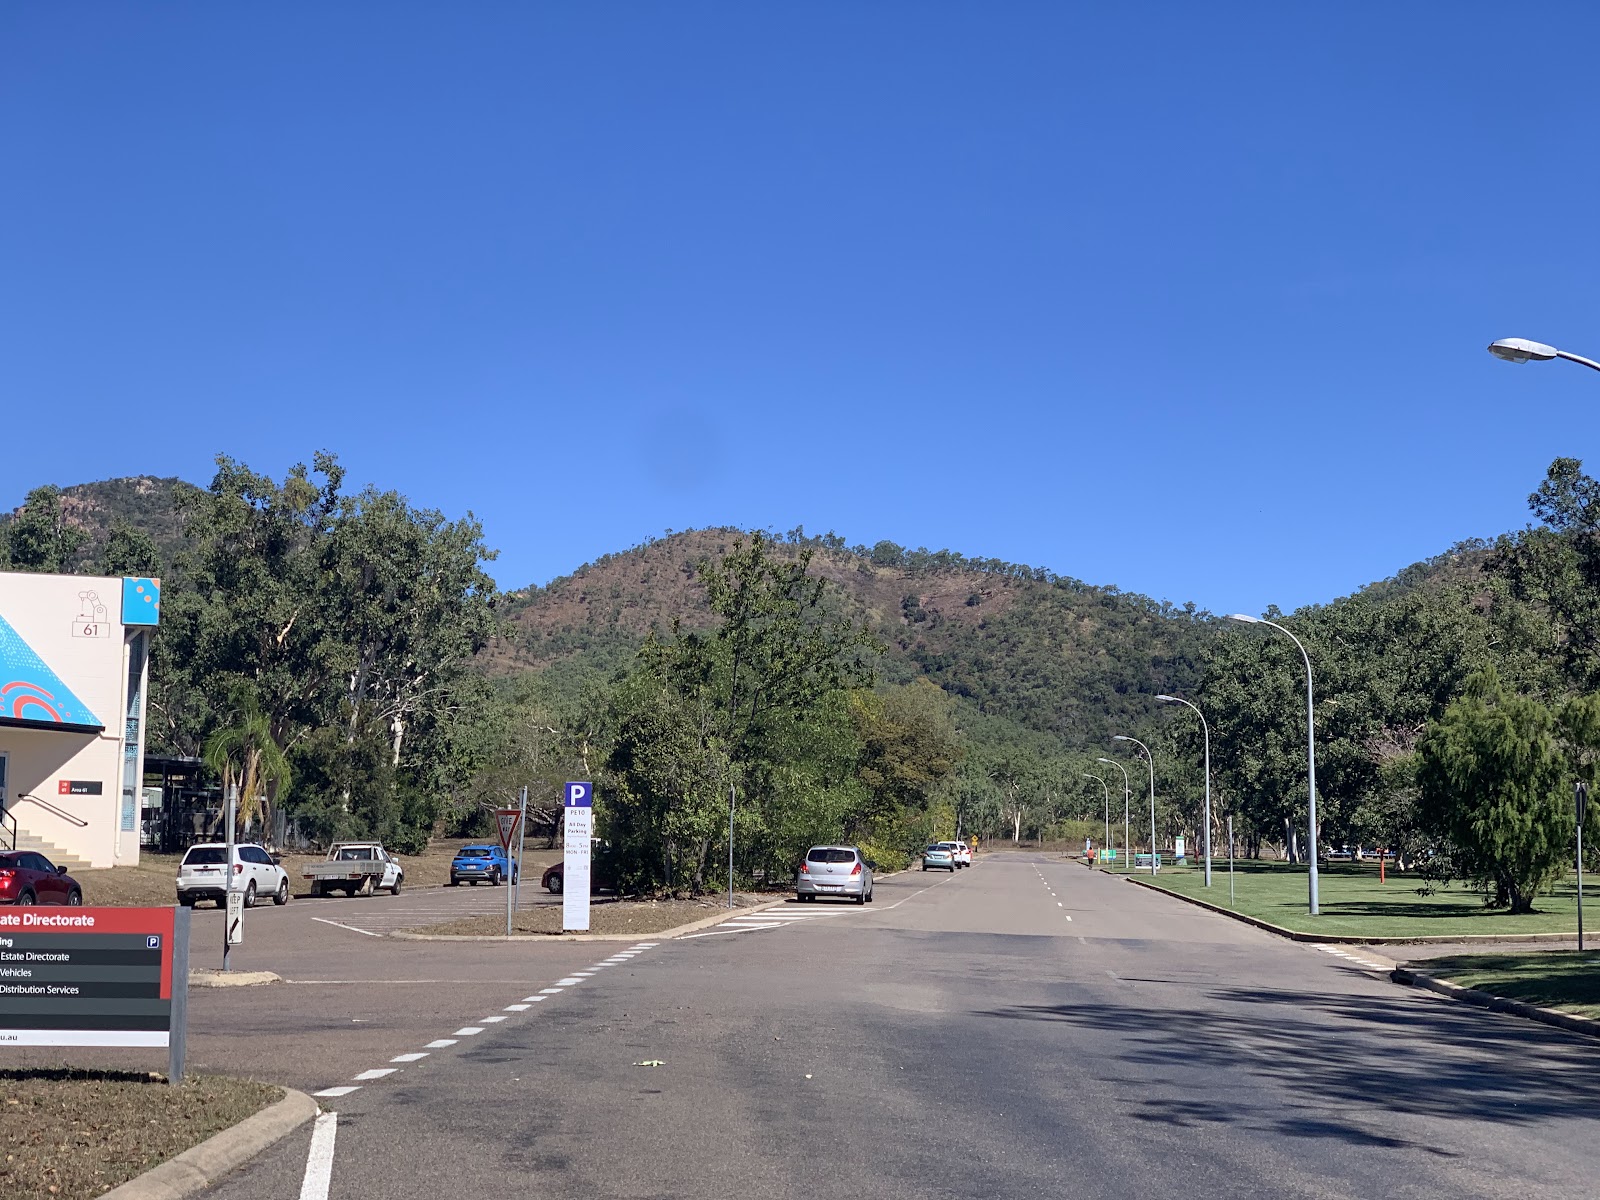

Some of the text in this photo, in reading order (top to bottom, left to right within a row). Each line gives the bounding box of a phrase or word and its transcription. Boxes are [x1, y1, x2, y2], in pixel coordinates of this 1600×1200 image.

[83, 624, 98, 636] 61
[570, 785, 586, 806] P
[501, 817, 513, 825] GIVE
[23, 913, 95, 926] Directorate
[150, 937, 157, 947] P
[1, 952, 70, 961] Estate Directorate
[0, 968, 32, 977] Vehicles
[0, 985, 79, 995] Distribution Services
